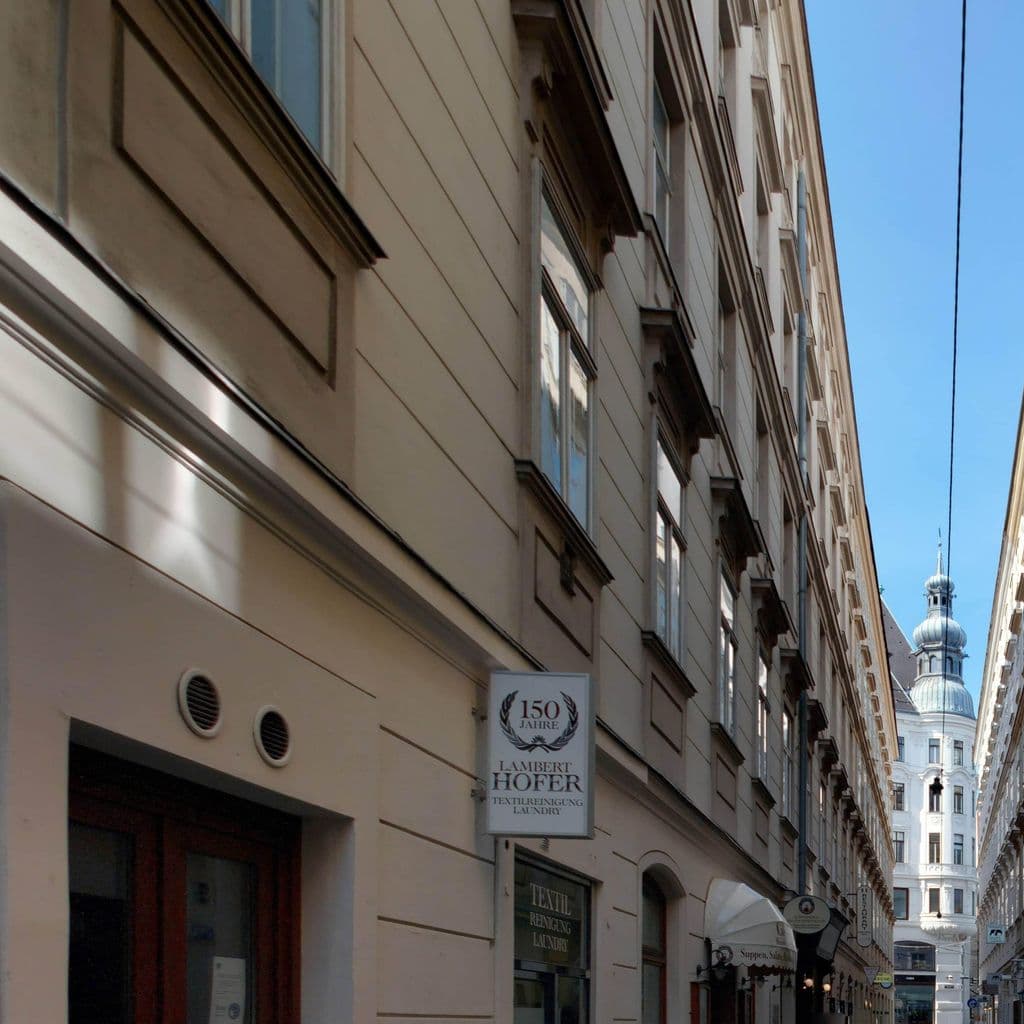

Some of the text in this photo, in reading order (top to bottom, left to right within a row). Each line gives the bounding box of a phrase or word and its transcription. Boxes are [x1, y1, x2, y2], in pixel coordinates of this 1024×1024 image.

[520, 700, 560, 719] 150
[519, 720, 559, 730] JAHRE
[499, 760, 572, 773] LAMBERT
[491, 772, 584, 793] HOFER
[491, 796, 584, 807] TEXTILREINIGUNG
[513, 806, 562, 816] LAUNDRY
[530, 882, 572, 916] TEXTIL
[529, 911, 572, 935] REINIGUNG
[532, 931, 569, 953] LAUNDRY
